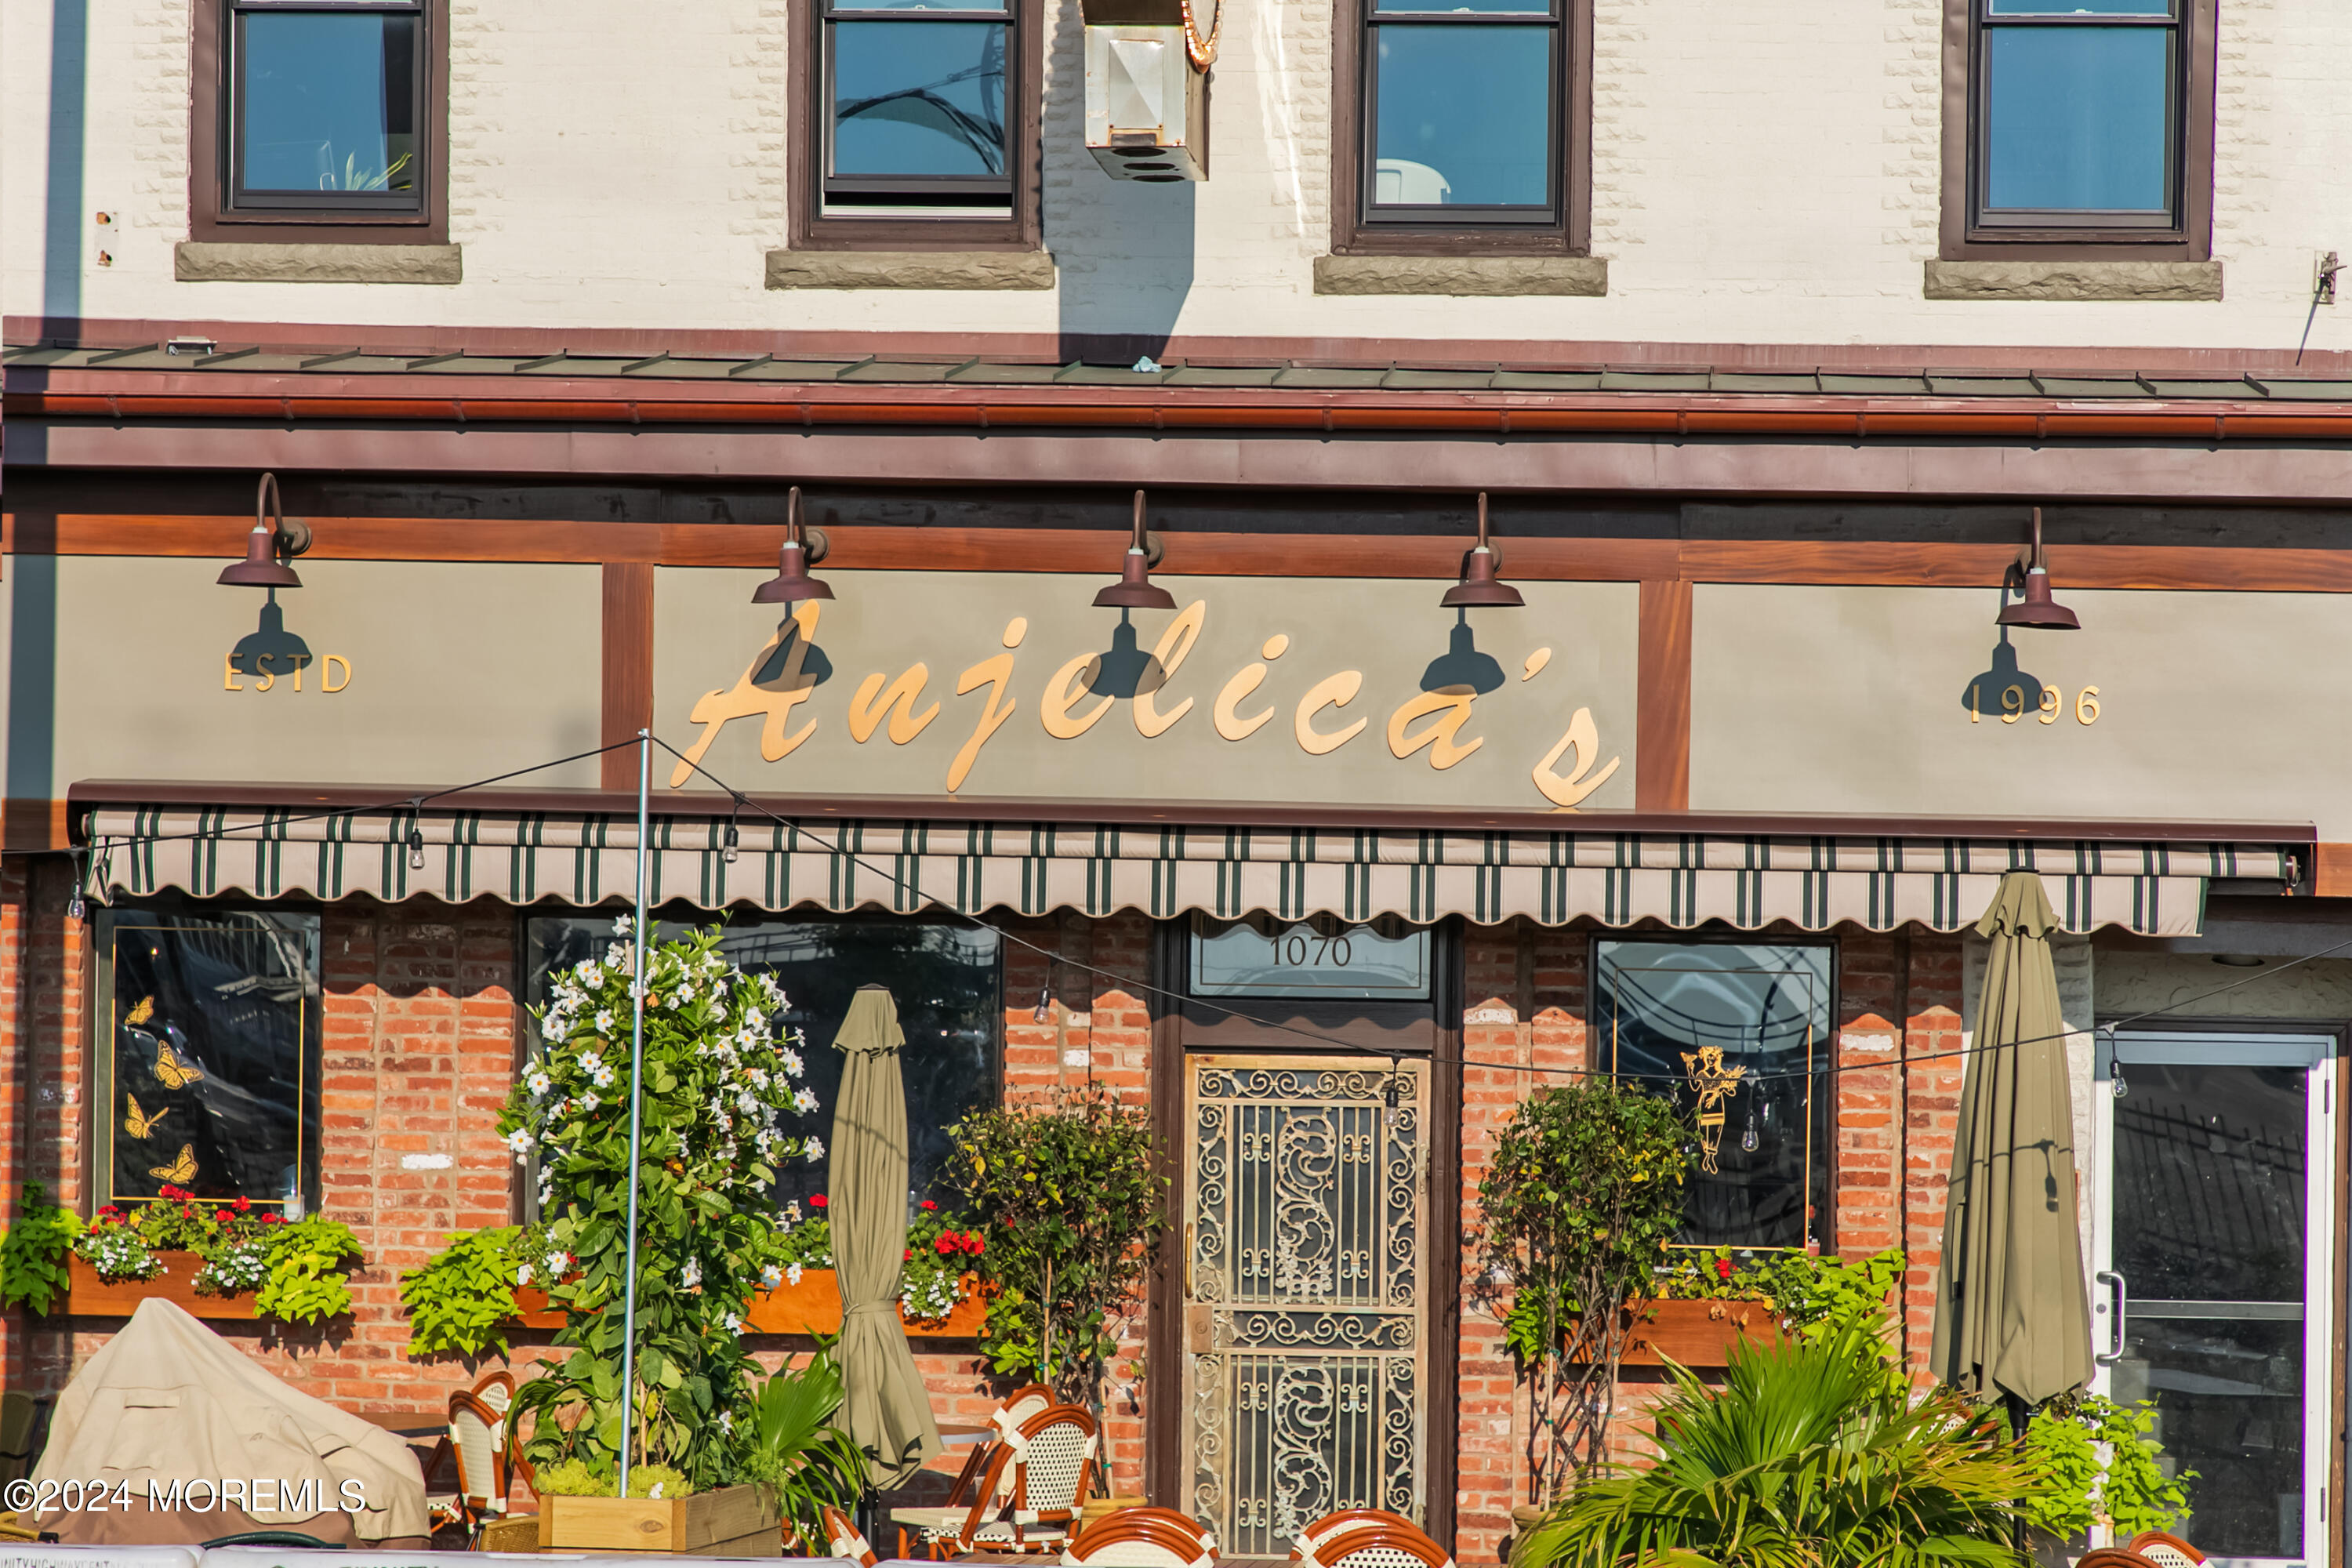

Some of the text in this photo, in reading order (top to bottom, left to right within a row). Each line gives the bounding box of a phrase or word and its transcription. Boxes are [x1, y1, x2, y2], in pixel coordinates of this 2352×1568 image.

[224, 653, 351, 692] ESTD
[670, 598, 1621, 807] Anjelica's
[1972, 684, 2100, 724] 1996
[1270, 936, 1352, 966] 1070
